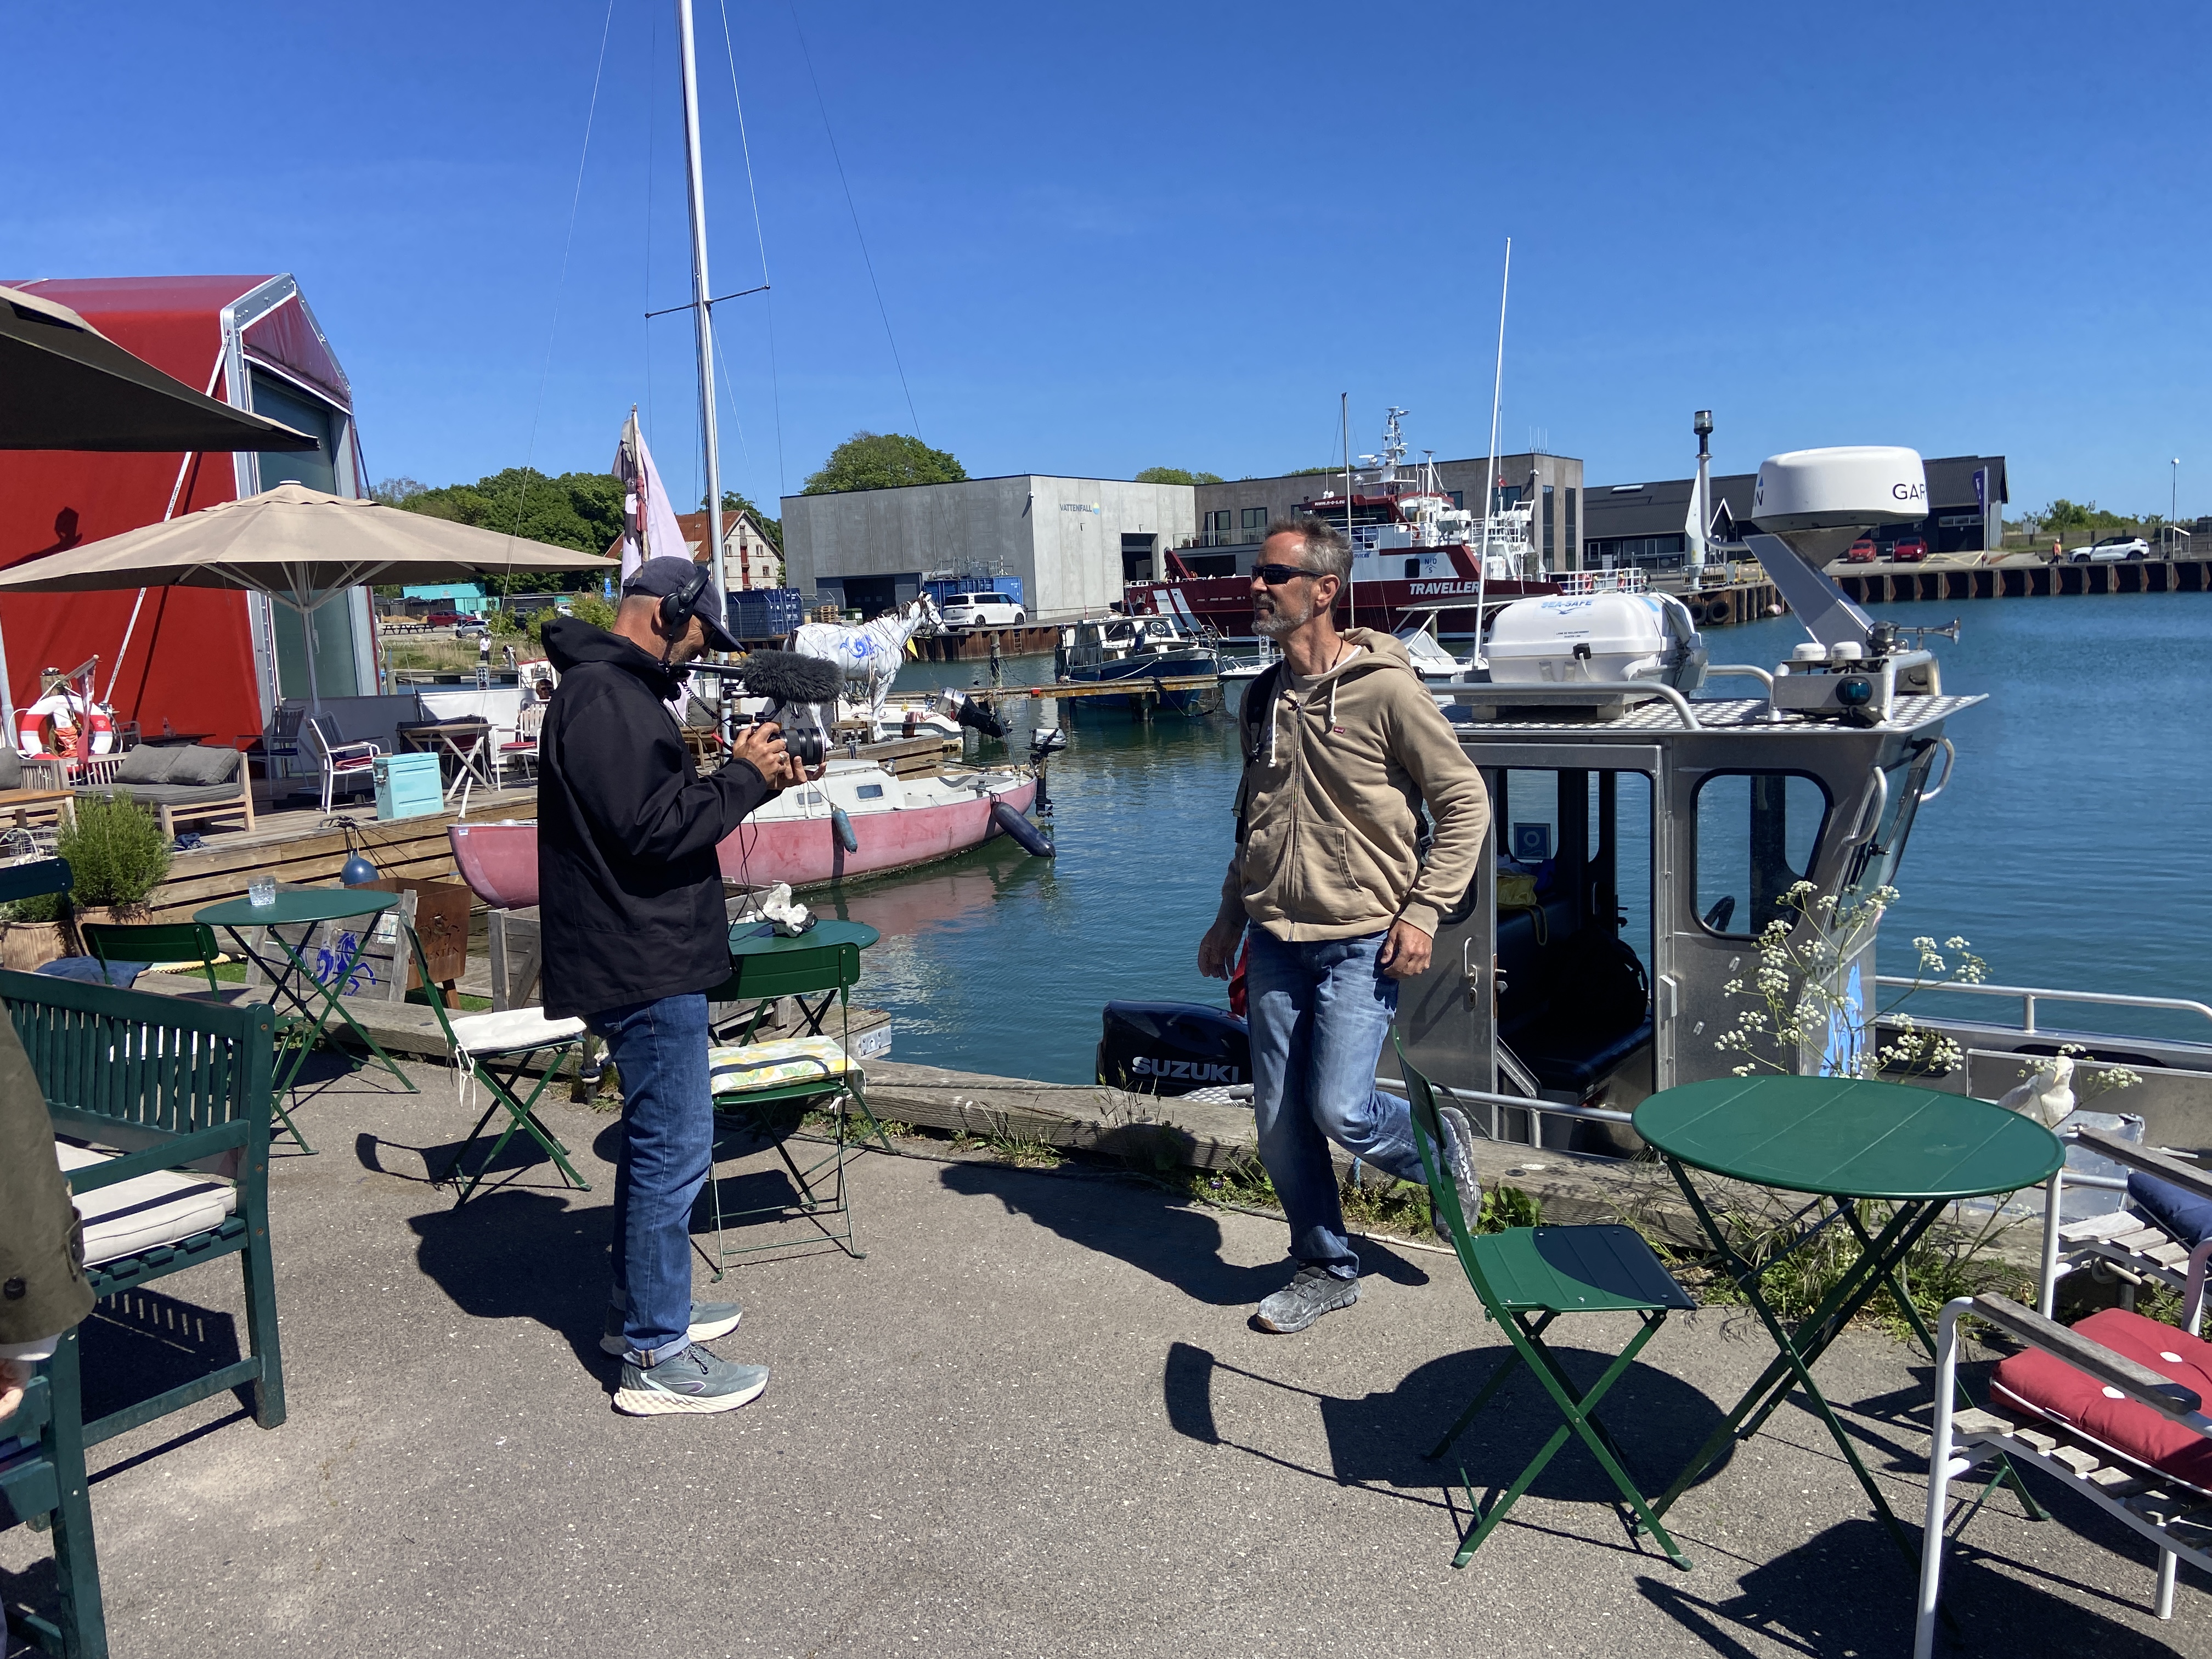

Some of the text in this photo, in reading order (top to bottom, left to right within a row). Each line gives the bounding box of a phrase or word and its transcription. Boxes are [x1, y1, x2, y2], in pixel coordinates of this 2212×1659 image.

[1892, 483, 1926, 500] GAR
[1059, 503, 1092, 512] VATTENFALL
[1409, 581, 1480, 595] TRAVELLER
[1541, 599, 1593, 608] SEA-SAFE
[1132, 1057, 1239, 1083] SUZUKI
